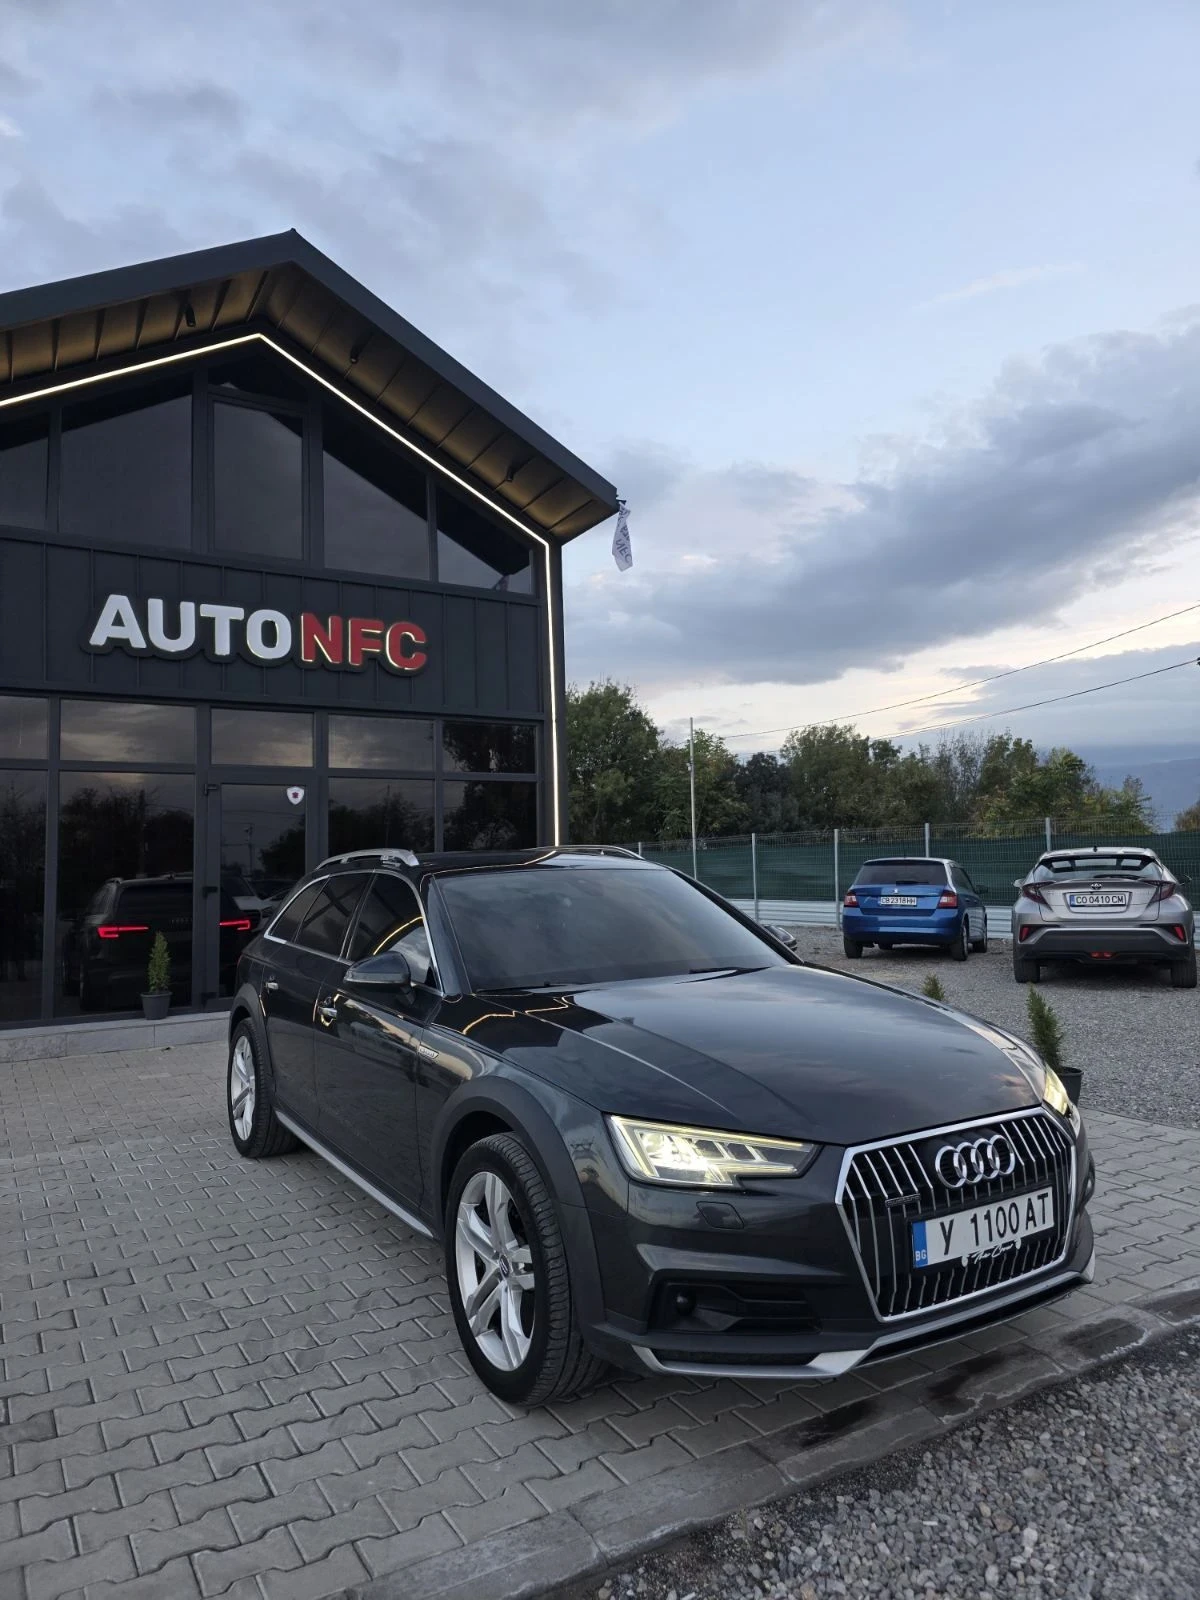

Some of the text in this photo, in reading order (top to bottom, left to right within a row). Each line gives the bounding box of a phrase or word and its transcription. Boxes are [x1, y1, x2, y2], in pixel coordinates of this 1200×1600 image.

[1076, 895, 1124, 904] CO 0410 CM
[970, 1201, 1020, 1247] 1100
[1025, 1192, 1049, 1230] AT
[915, 1249, 927, 1261] BG
